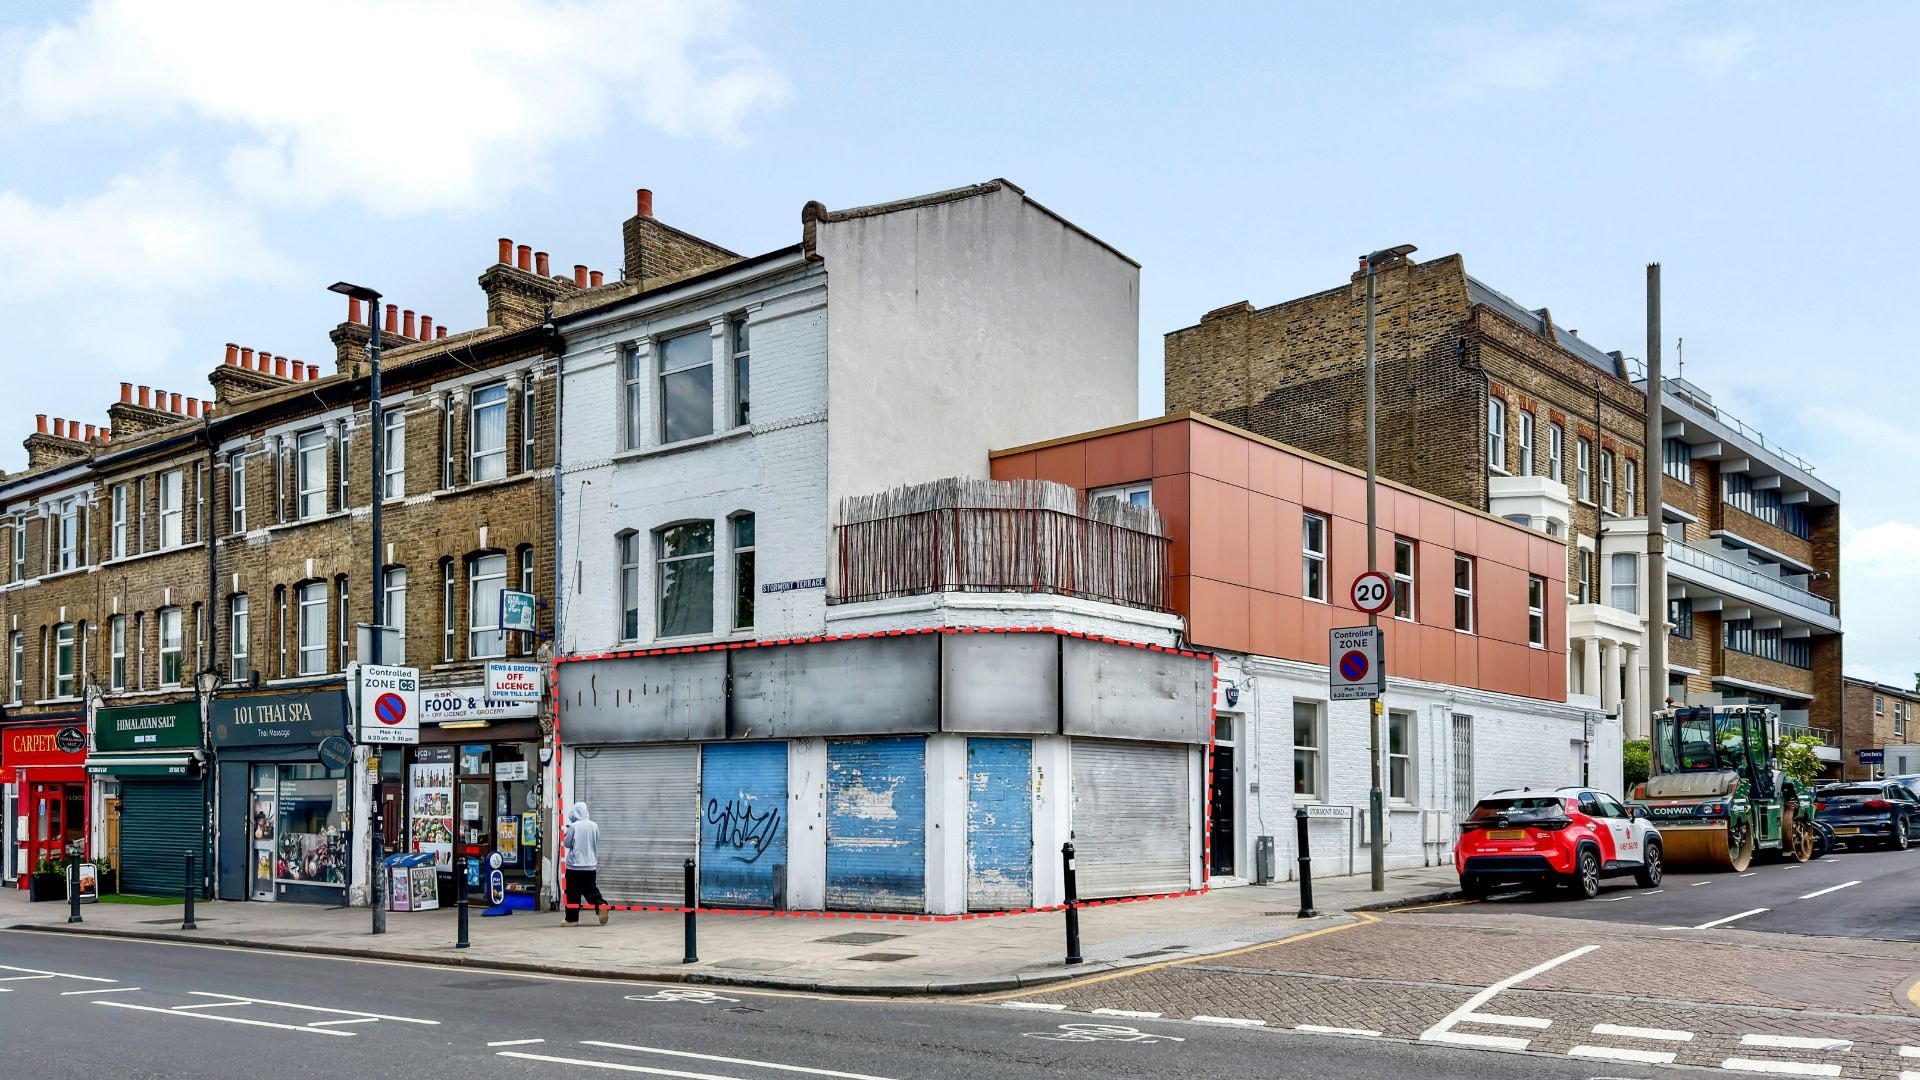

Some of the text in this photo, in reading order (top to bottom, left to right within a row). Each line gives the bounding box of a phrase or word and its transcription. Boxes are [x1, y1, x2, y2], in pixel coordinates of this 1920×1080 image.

[762, 578, 823, 592] STORMONT TERRACE
[1357, 584, 1384, 601] 20
[1334, 630, 1373, 639] Controlled
[1340, 639, 1368, 648] ZONE
[369, 668, 412, 677] Controlled
[365, 679, 414, 690] ZONE C3
[425, 698, 462, 712] FOOD
[468, 697, 476, 709] &
[234, 703, 312, 724] 101 THAI SPA
[117, 716, 176, 731] HIMALAYAN SALT
[14, 734, 60, 752] CARPETM
